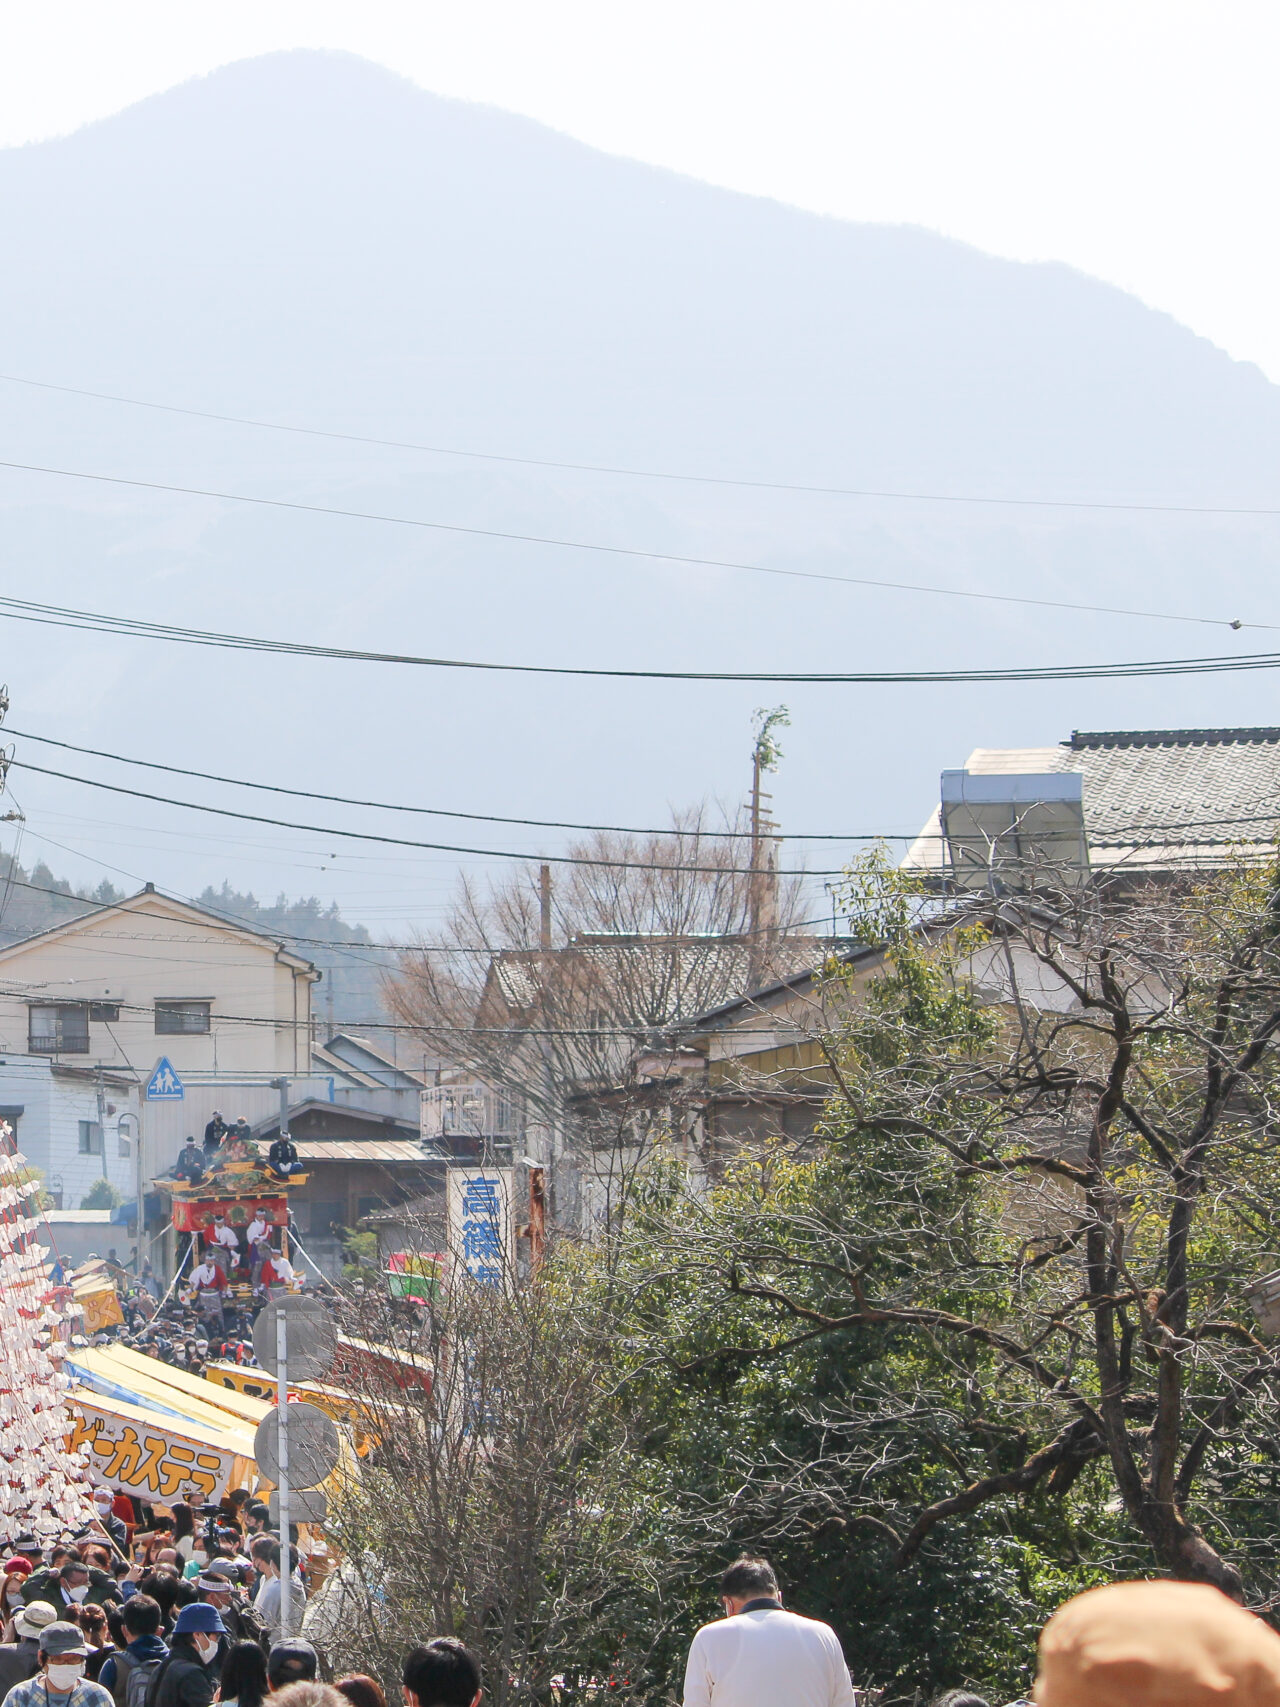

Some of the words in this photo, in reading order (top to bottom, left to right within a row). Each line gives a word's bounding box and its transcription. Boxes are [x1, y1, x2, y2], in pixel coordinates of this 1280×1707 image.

[63, 1406, 221, 1501] ビーカステラ
